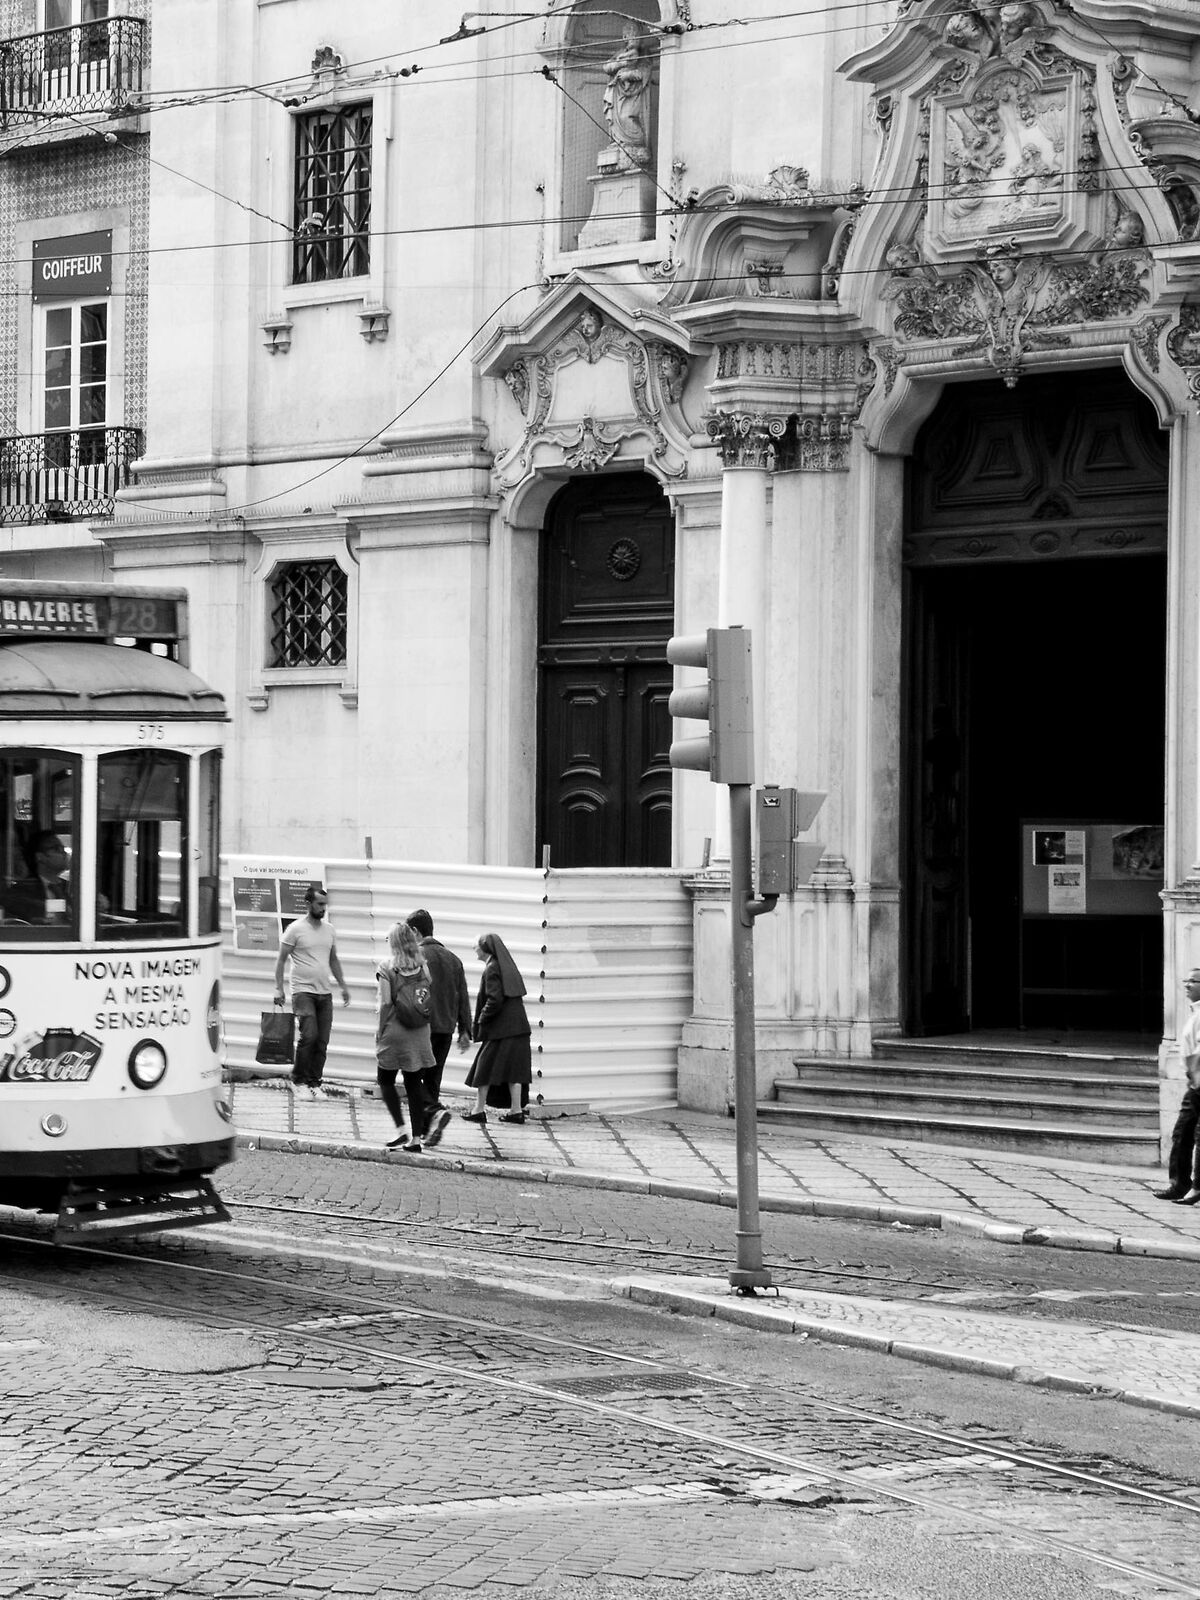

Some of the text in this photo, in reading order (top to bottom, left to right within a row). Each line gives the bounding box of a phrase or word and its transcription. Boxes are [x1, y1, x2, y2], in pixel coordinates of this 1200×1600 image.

[43, 255, 102, 280] COIFFEUR
[121, 603, 157, 632] 28
[138, 724, 165, 740] 575
[75, 958, 200, 980] NOVA IMAGEM
[103, 984, 185, 1004] A MESMA
[95, 1004, 191, 1030] SENSAÇÃO
